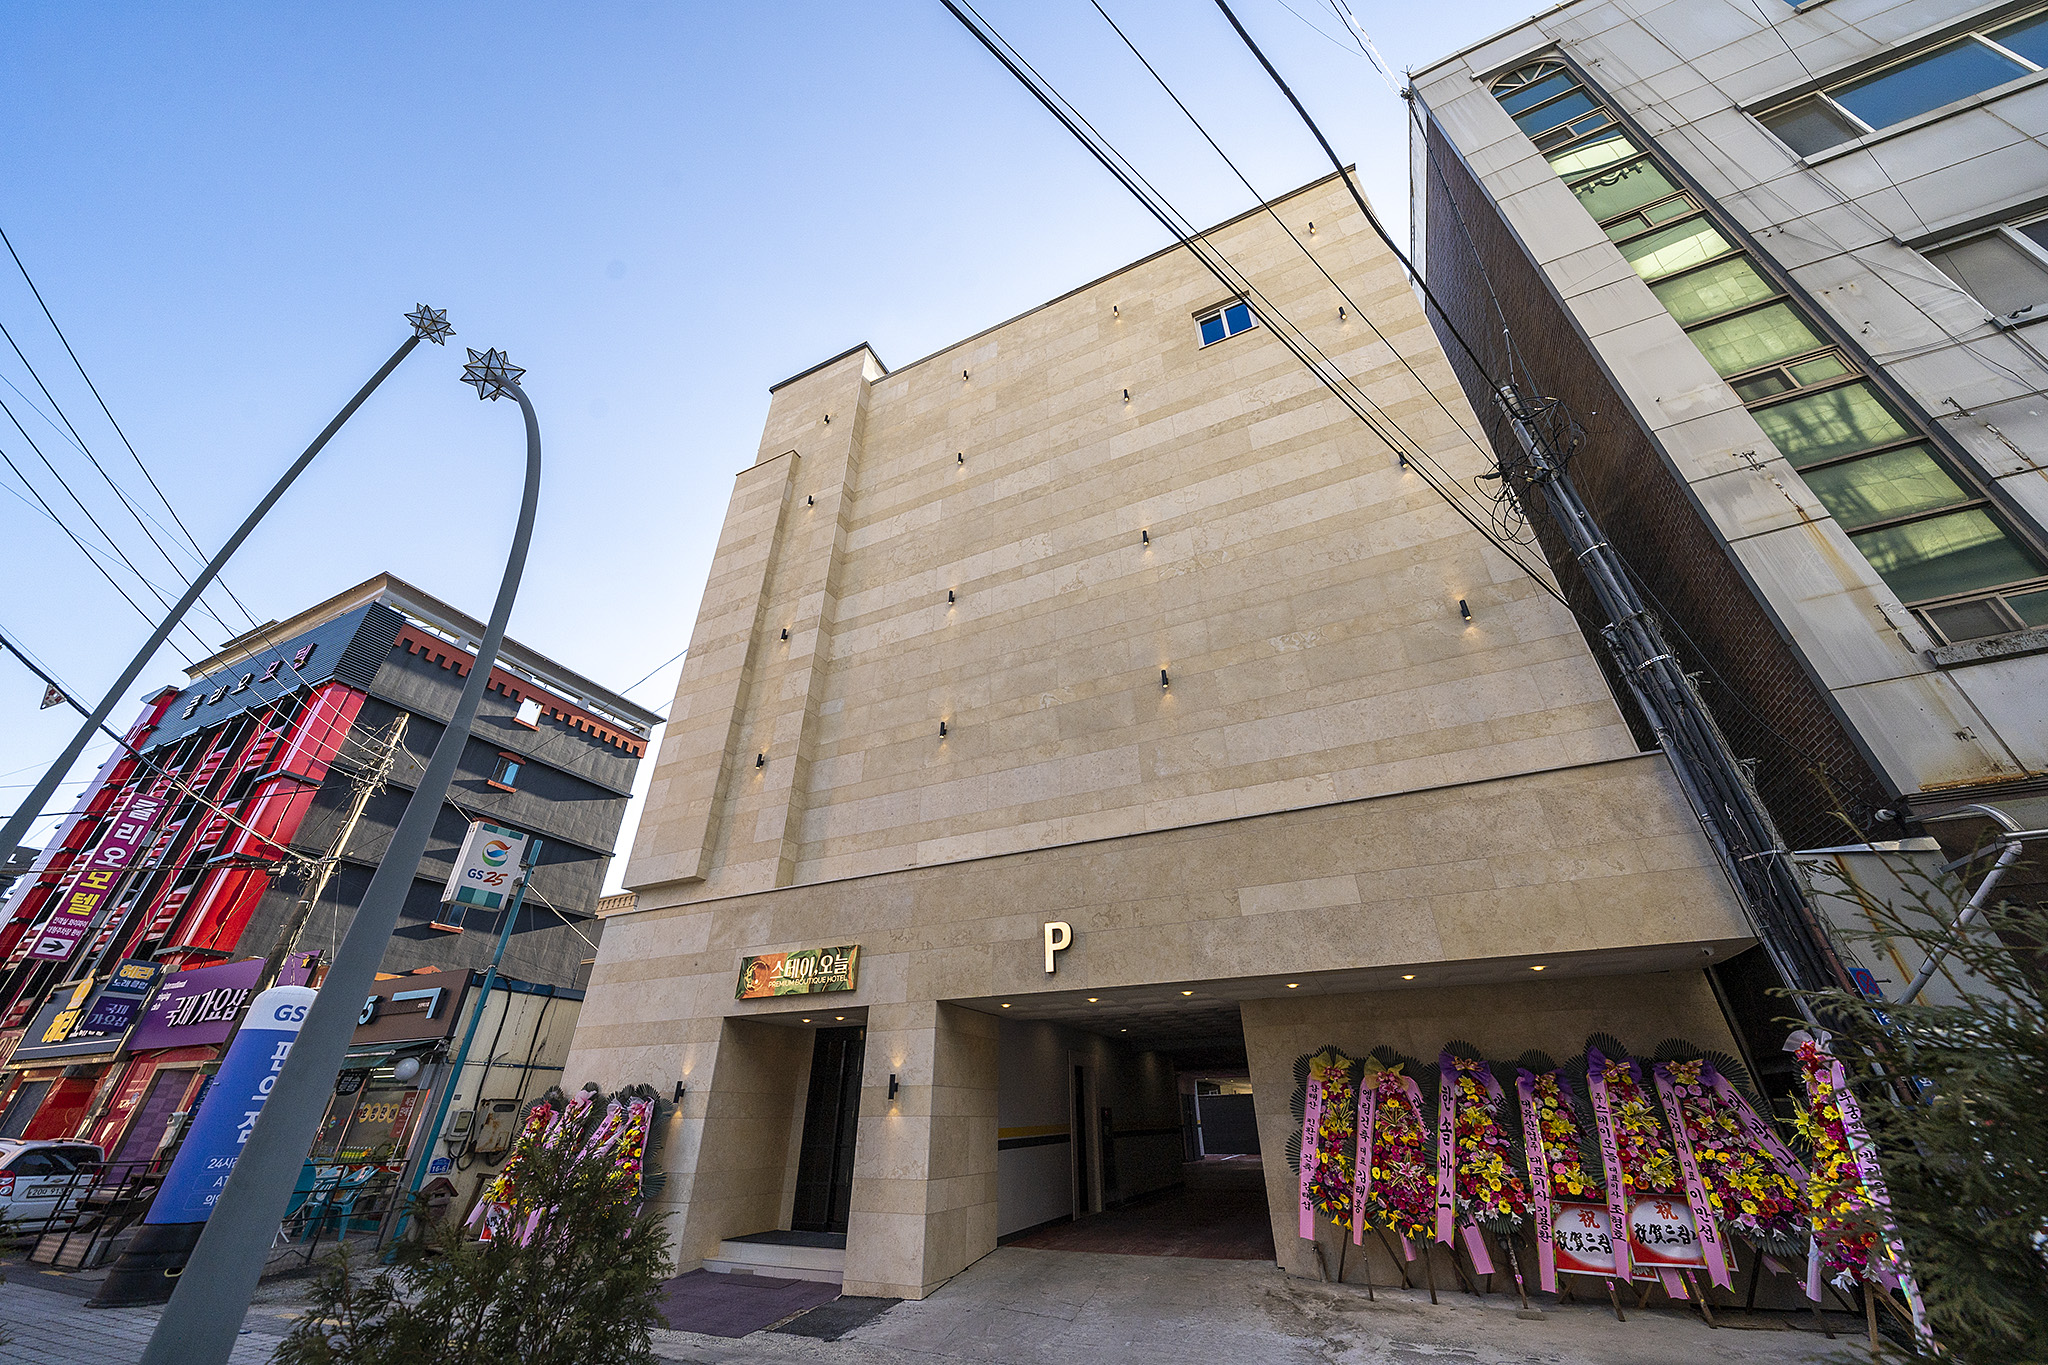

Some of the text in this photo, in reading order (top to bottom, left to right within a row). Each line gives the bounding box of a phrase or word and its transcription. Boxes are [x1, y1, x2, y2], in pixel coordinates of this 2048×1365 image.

[467, 868, 508, 886] GS25
[1044, 921, 1073, 974] P
[119, 963, 156, 980] 헤라
[768, 974, 848, 988] PREMIUM BOUTIQUE HOTEL
[105, 1003, 130, 1015] 국제
[1530, 1156, 1549, 1202] 대표이사
[1683, 1160, 1698, 1182] 대표
[1608, 1166, 1621, 1199] 대표이사
